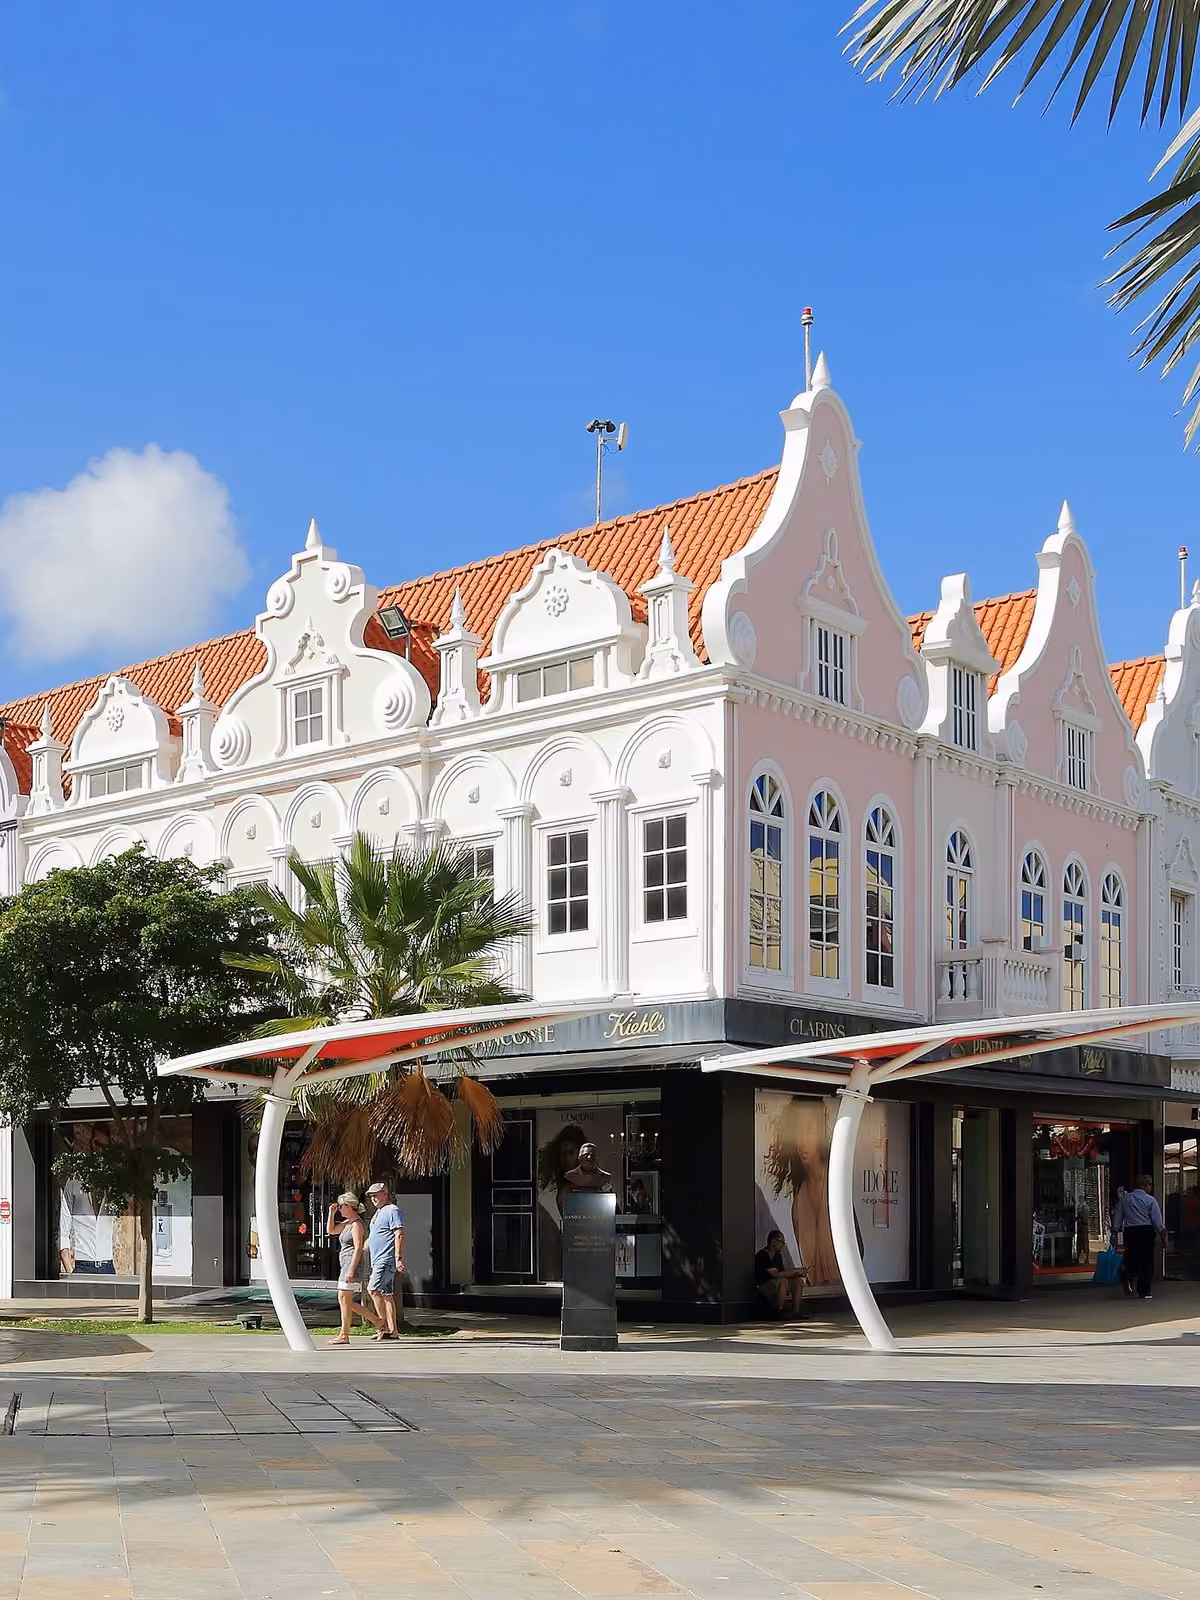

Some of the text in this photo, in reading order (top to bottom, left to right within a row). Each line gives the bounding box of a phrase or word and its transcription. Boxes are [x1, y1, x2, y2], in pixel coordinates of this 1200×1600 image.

[467, 1024, 556, 1048] COME
[603, 1010, 666, 1044] Kiehl's
[790, 1018, 846, 1039] CLARINS
